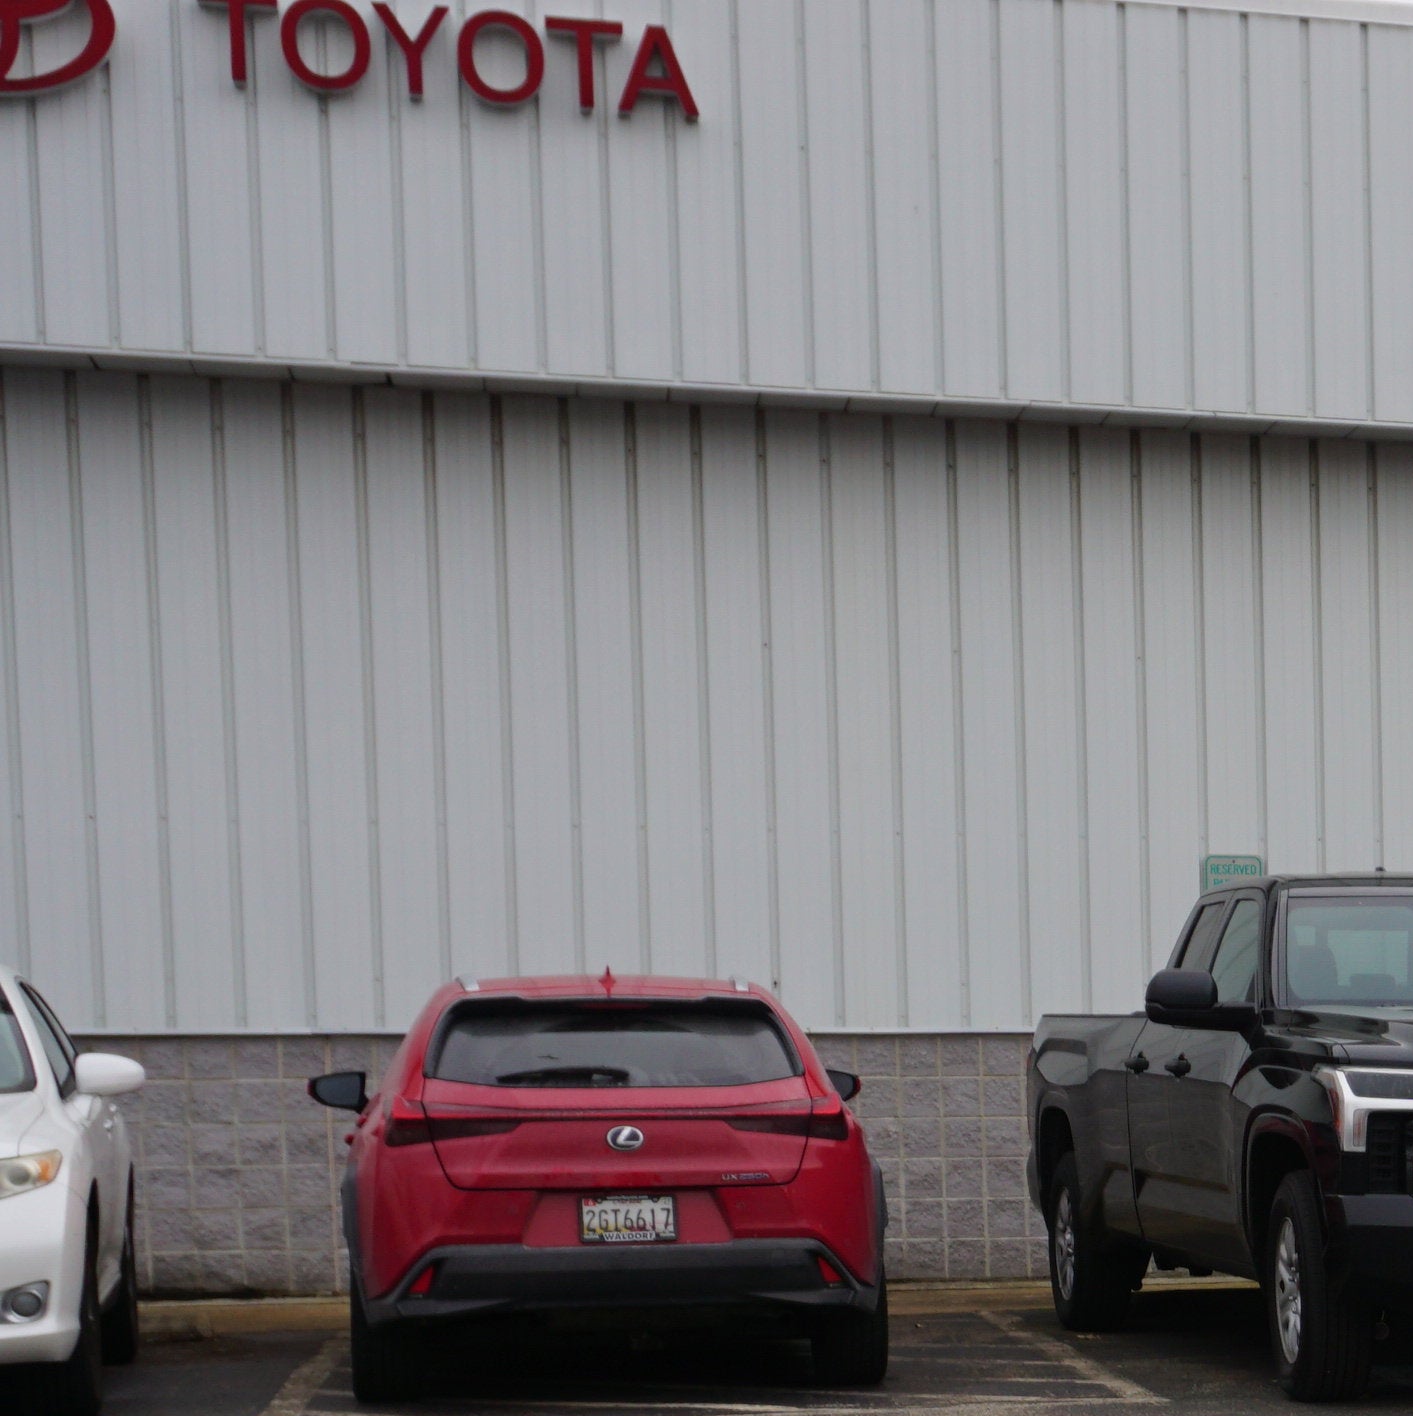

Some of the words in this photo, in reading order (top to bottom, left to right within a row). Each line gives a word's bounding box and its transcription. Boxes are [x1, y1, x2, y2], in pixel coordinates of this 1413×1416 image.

[202, 0, 699, 122] TOYOTA
[1210, 864, 1257, 876] RESERVED
[604, 1232, 654, 1241] WALDORF
